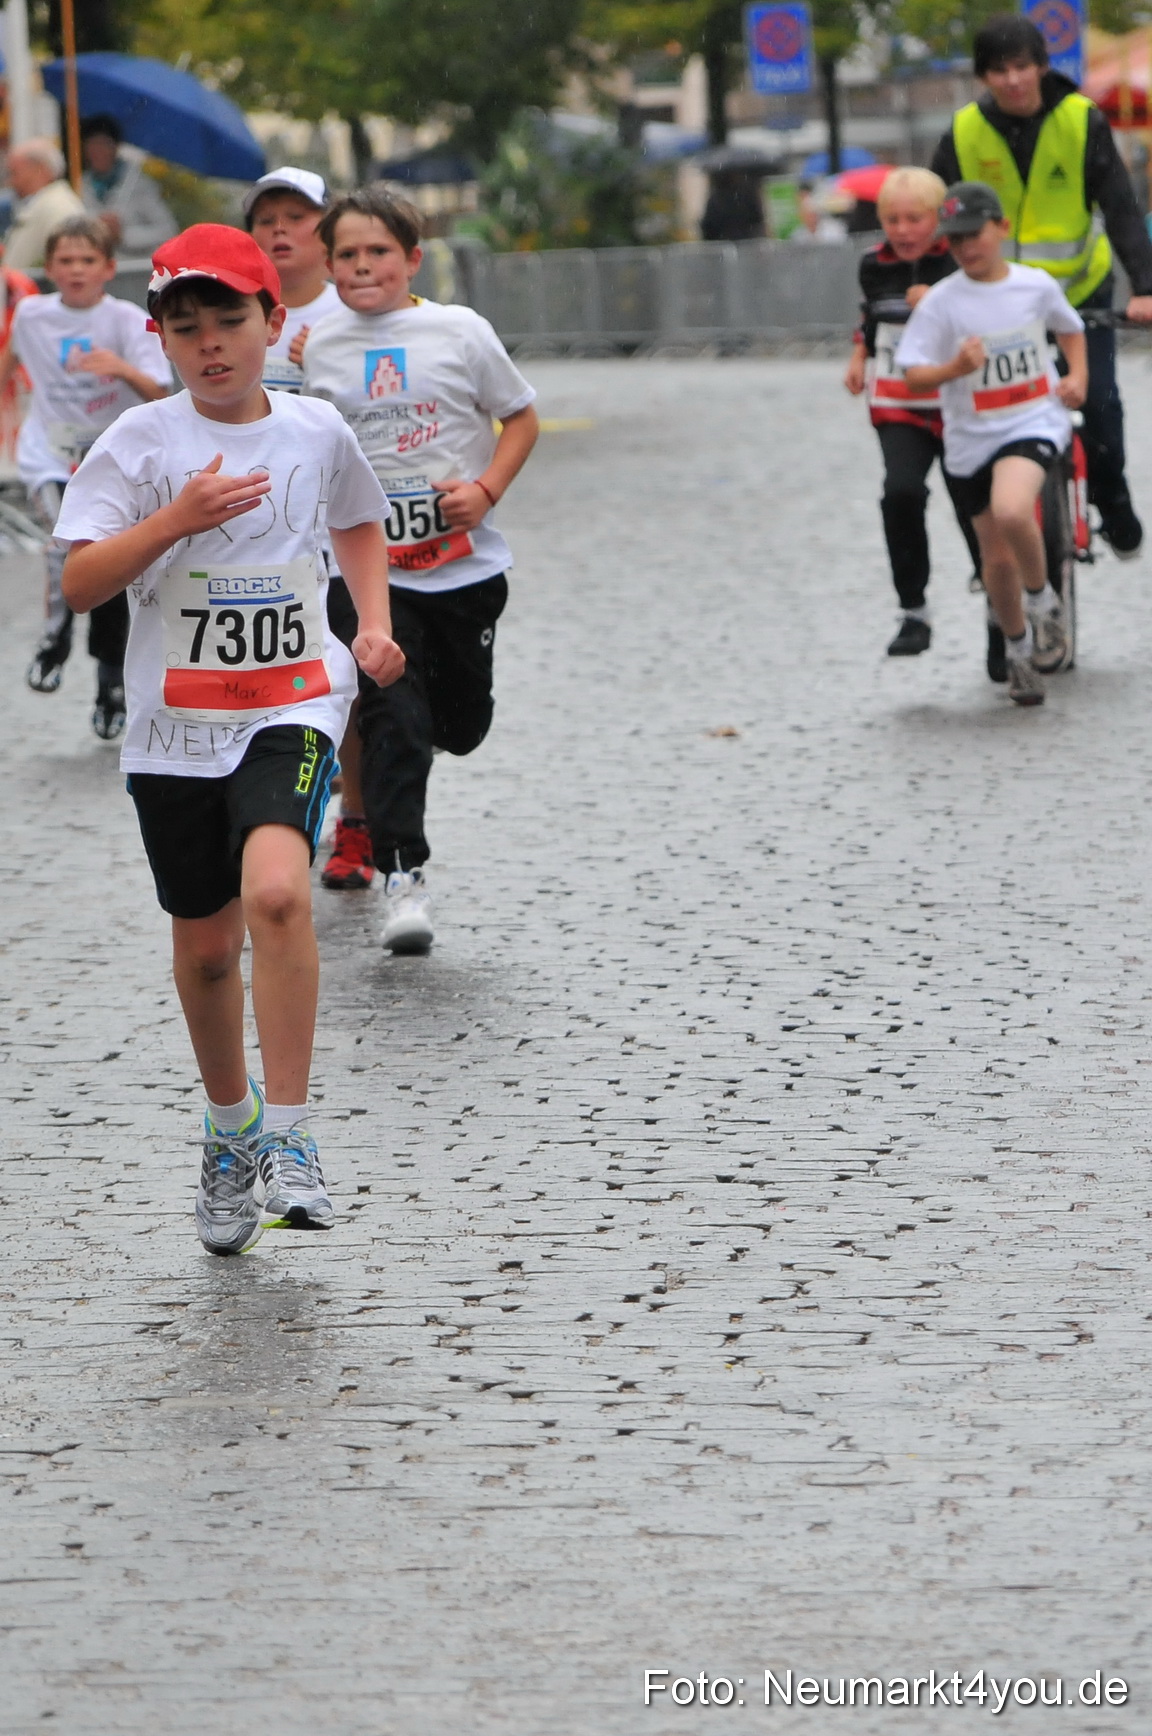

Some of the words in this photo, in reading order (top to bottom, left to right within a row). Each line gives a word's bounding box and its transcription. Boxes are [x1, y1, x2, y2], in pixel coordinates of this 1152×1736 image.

[414, 401, 437, 416] TV
[397, 421, 439, 453] 2011
[388, 545, 440, 571] atrick
[208, 576, 281, 594] BOCK
[181, 602, 305, 666] 7305
[224, 682, 272, 699] Marc
